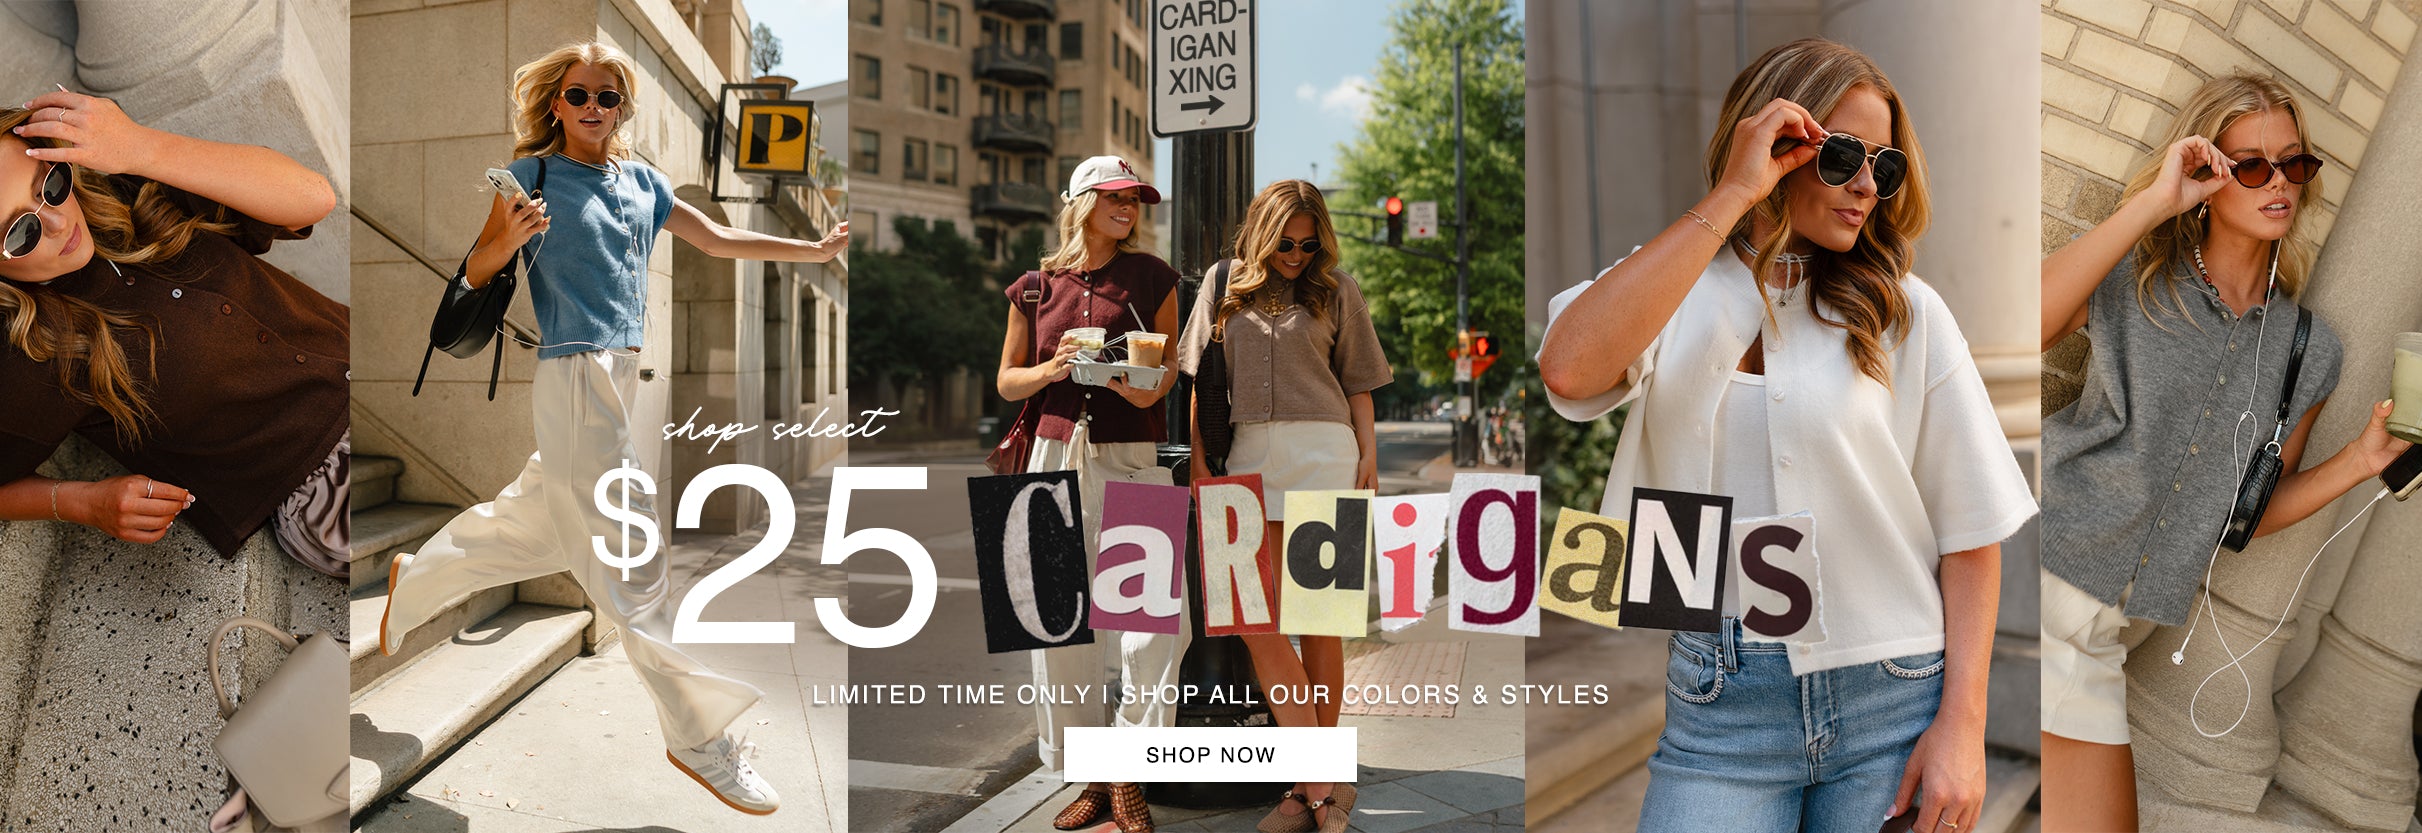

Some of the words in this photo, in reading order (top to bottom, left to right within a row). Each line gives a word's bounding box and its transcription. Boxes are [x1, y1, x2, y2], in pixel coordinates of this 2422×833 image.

[1160, 0, 1247, 30] CARD-
[1171, 30, 1236, 62] IGAN
[1168, 63, 1236, 95] XING
[745, 113, 804, 164] P
